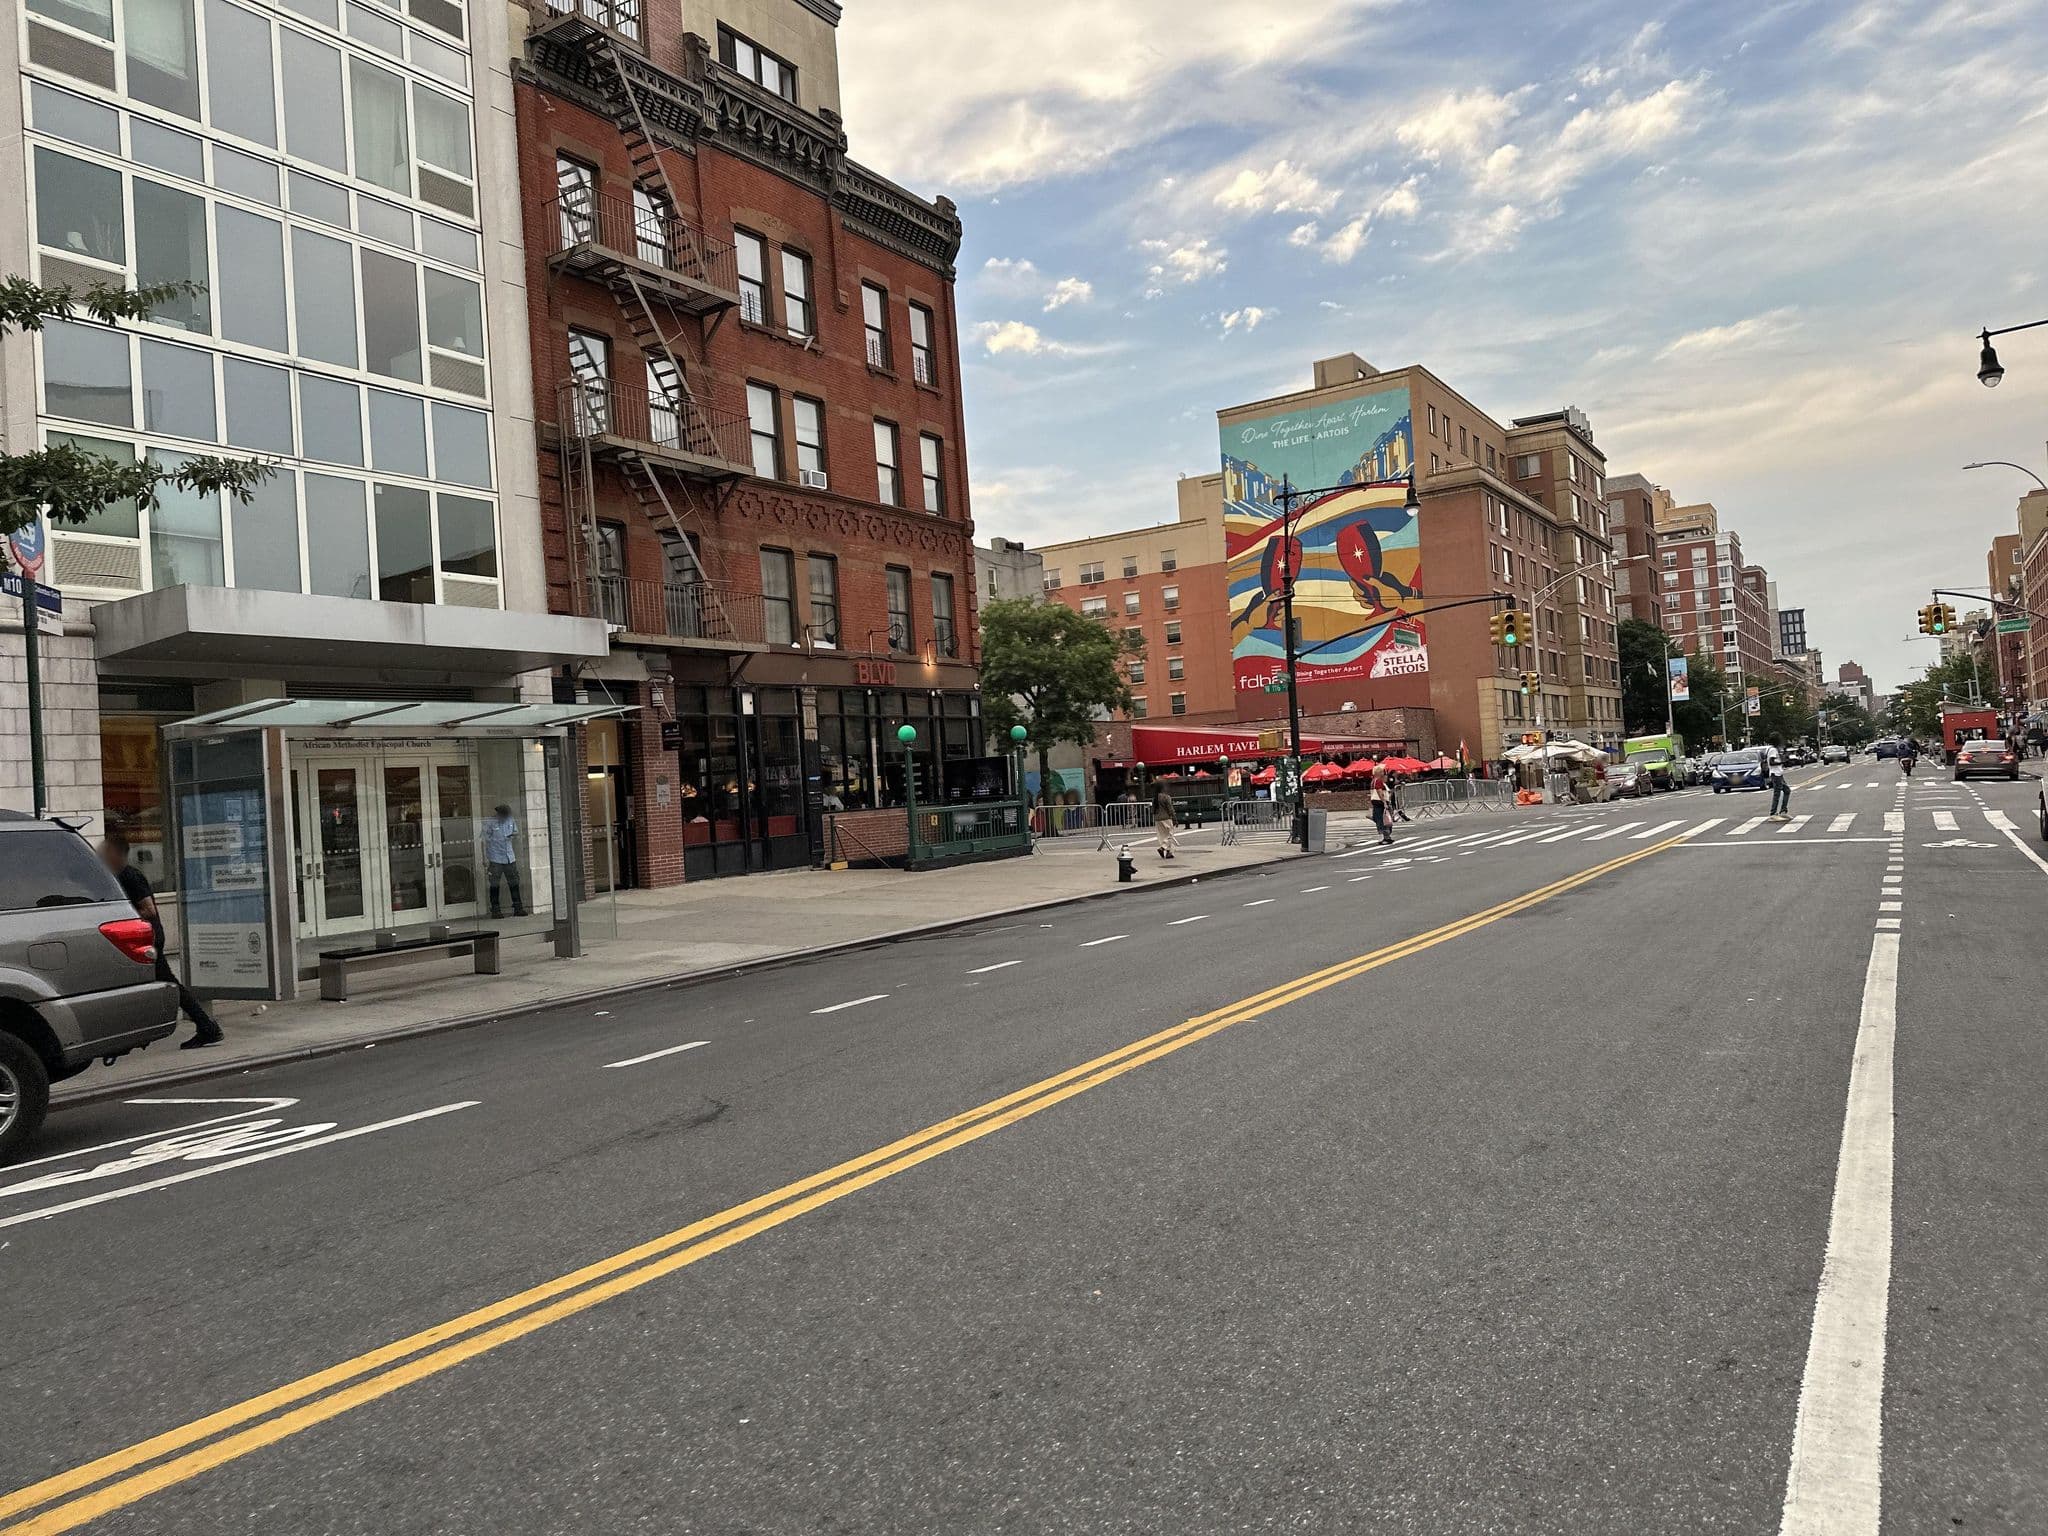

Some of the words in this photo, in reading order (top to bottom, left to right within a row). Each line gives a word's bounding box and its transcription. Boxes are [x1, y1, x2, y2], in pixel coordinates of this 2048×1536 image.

[1241, 428, 1268, 444] Dine
[1271, 420, 1314, 438] Together
[1349, 404, 1390, 427] Harlem
[1272, 439, 1289, 449] THE
[1291, 435, 1310, 446] LIFE
[1315, 427, 1350, 440] ARTOIS
[3, 577, 22, 594] M10
[1383, 653, 1425, 667] STELLA
[857, 661, 896, 684] BLVD
[1313, 667, 1342, 675] Together
[1343, 665, 1363, 673] Apart
[1384, 663, 1426, 675] ARTOIS
[303, 741, 331, 749] African
[333, 740, 369, 749] Methodist
[371, 740, 404, 750] Episcopal
[406, 739, 432, 748] Church
[1176, 743, 1225, 757] HARLEM
